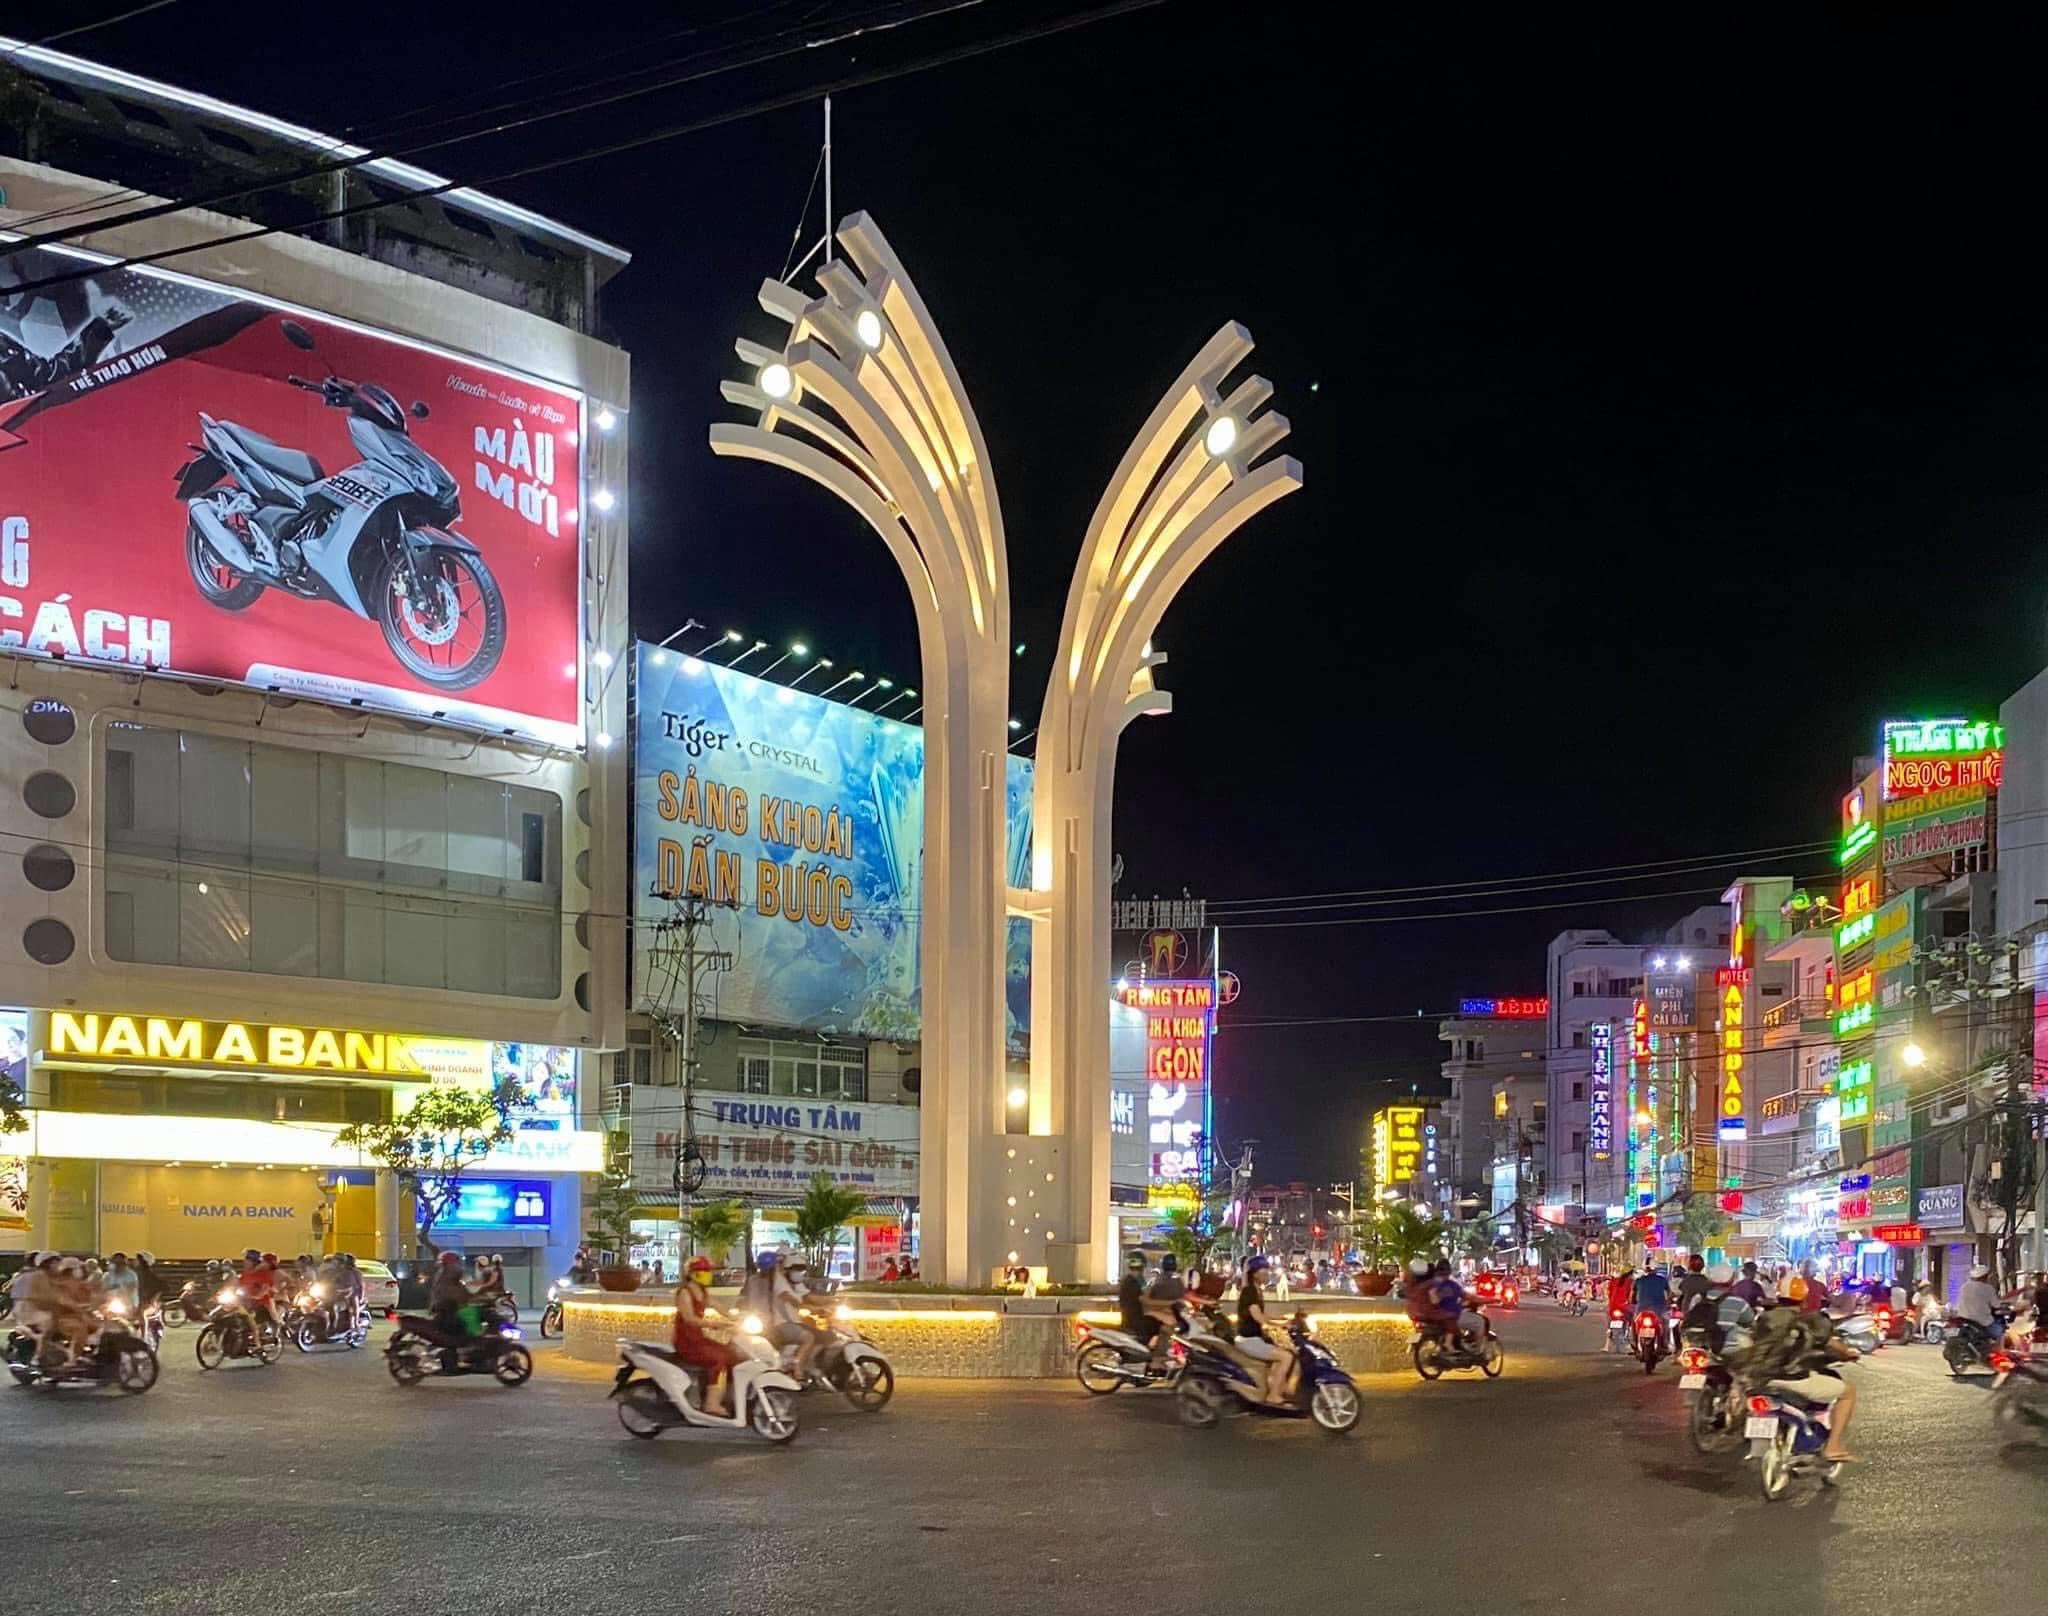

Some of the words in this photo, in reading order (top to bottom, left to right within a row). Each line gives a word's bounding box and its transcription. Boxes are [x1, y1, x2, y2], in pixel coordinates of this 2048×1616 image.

[95, 358, 131, 384] THAO
[475, 417, 554, 486] MÀU
[475, 461, 559, 538] MỚI
[661, 711, 729, 757] Tiger
[749, 741, 824, 774] CRYSTAL
[1888, 760, 1952, 794] NGỌC
[657, 764, 749, 836] SẢNG
[760, 794, 854, 860] KHOÁI
[657, 834, 742, 910] DẤN
[757, 858, 853, 932] BƯỚC
[1719, 970, 1749, 983] HOTEL
[1174, 984, 1211, 1007] TÂM
[51, 1012, 202, 1060] NAM
[213, 1023, 258, 1065] A
[268, 1027, 423, 1076] BANK
[1173, 1017, 1205, 1039] KHOA
[1156, 1041, 1204, 1080] GÒN
[712, 1101, 801, 1126] TRUNG
[807, 1104, 862, 1131] TÂM
[183, 1205, 226, 1217] NAM
[230, 1205, 242, 1217] A
[245, 1206, 295, 1218] BANK
[1918, 1196, 1957, 1213] QUANG
